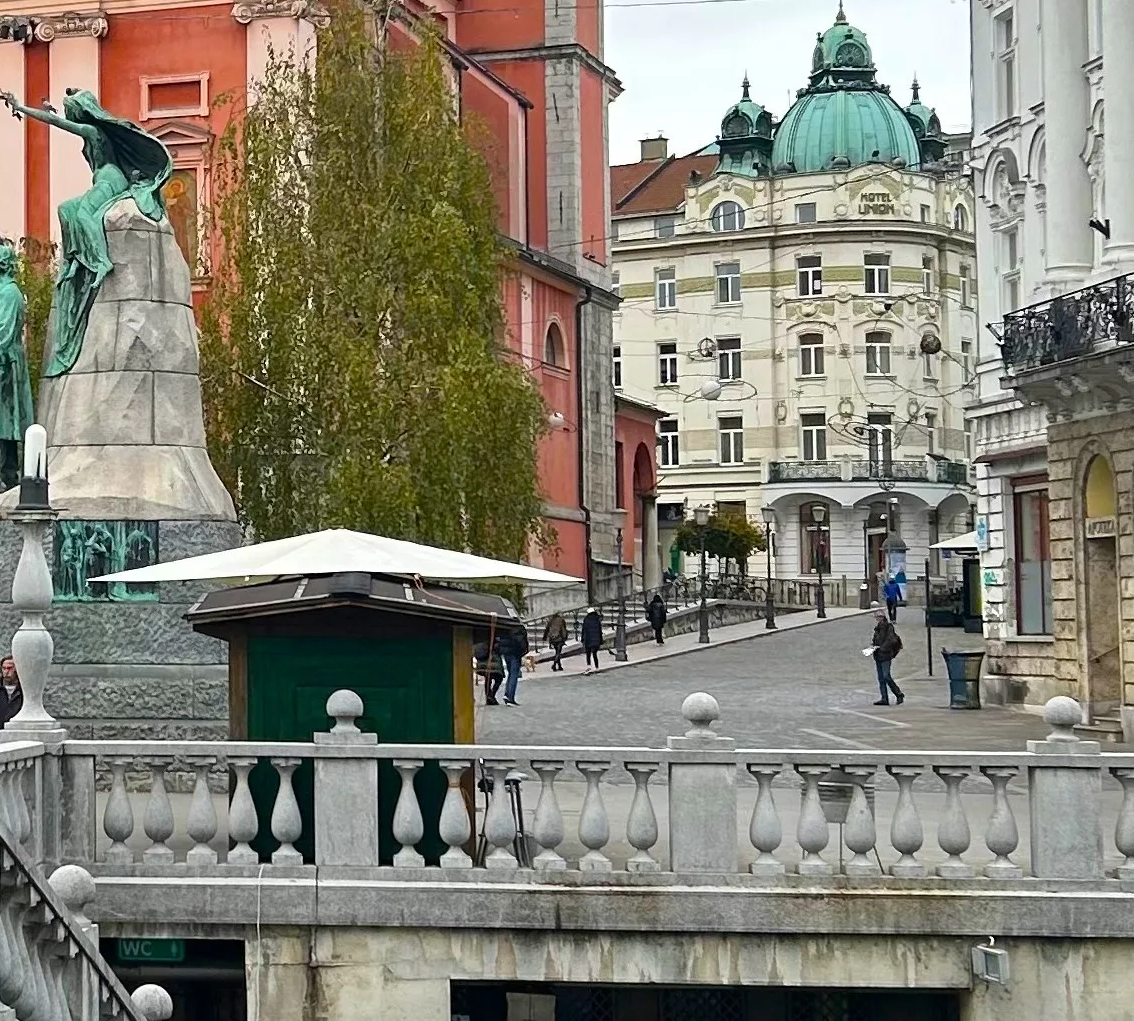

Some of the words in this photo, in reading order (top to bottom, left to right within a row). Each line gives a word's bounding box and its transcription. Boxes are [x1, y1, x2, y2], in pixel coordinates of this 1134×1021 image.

[860, 192, 893, 202] HOTEL
[858, 204, 895, 215] UNION
[122, 940, 152, 956] WC
